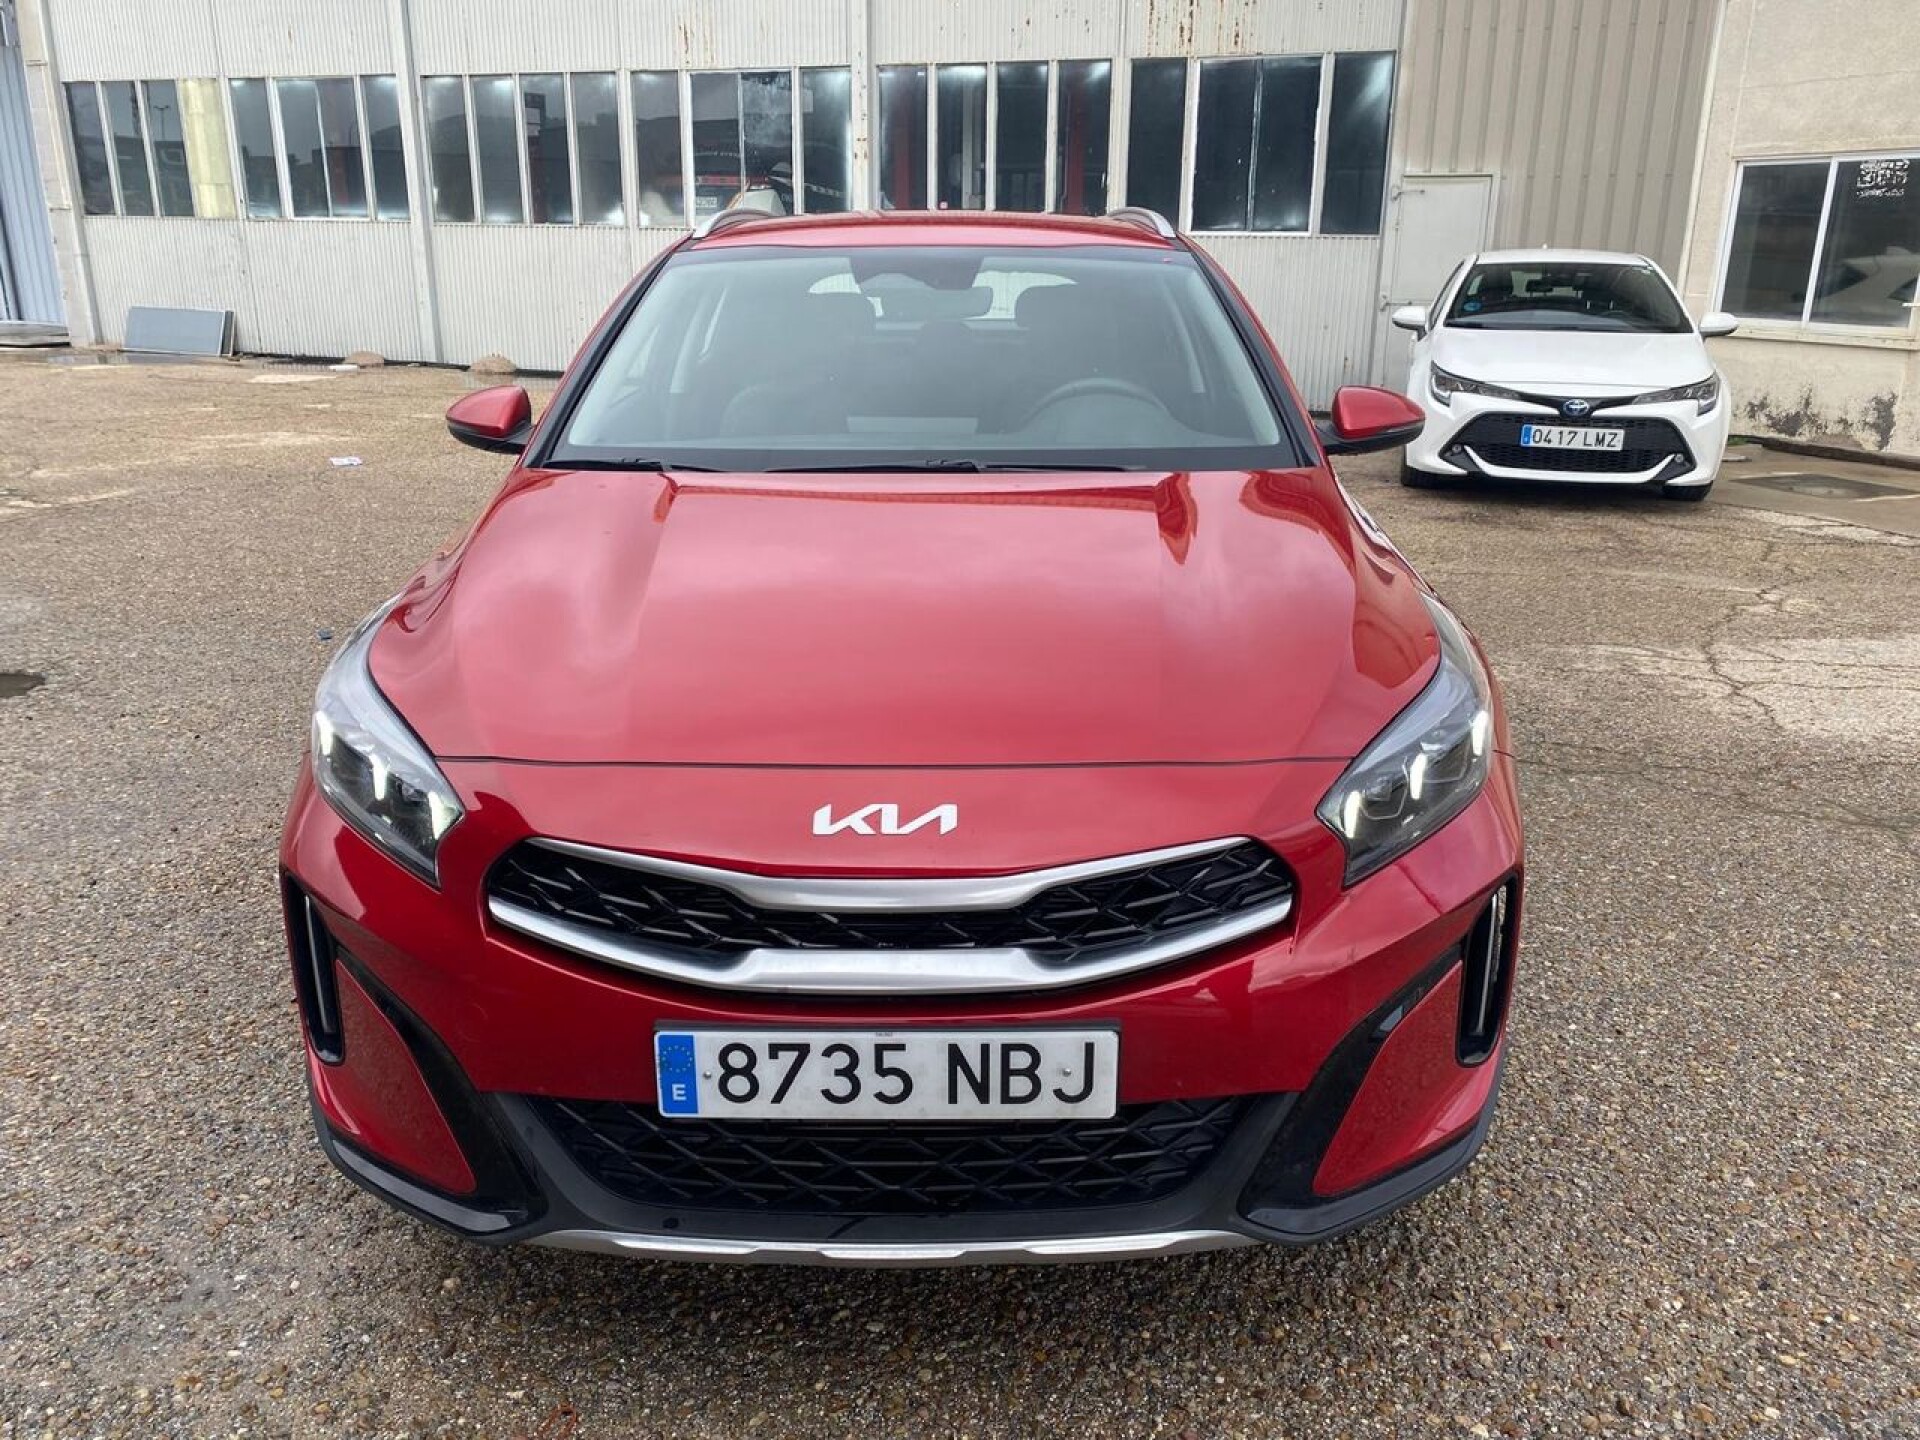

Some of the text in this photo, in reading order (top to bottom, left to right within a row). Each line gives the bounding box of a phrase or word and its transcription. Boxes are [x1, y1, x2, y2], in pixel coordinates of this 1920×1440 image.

[1532, 428, 1618, 448] 0417 LMZ
[813, 803, 958, 835] KIA
[717, 1041, 1096, 1105] 8735 NBJ
[672, 1083, 687, 1101] E
